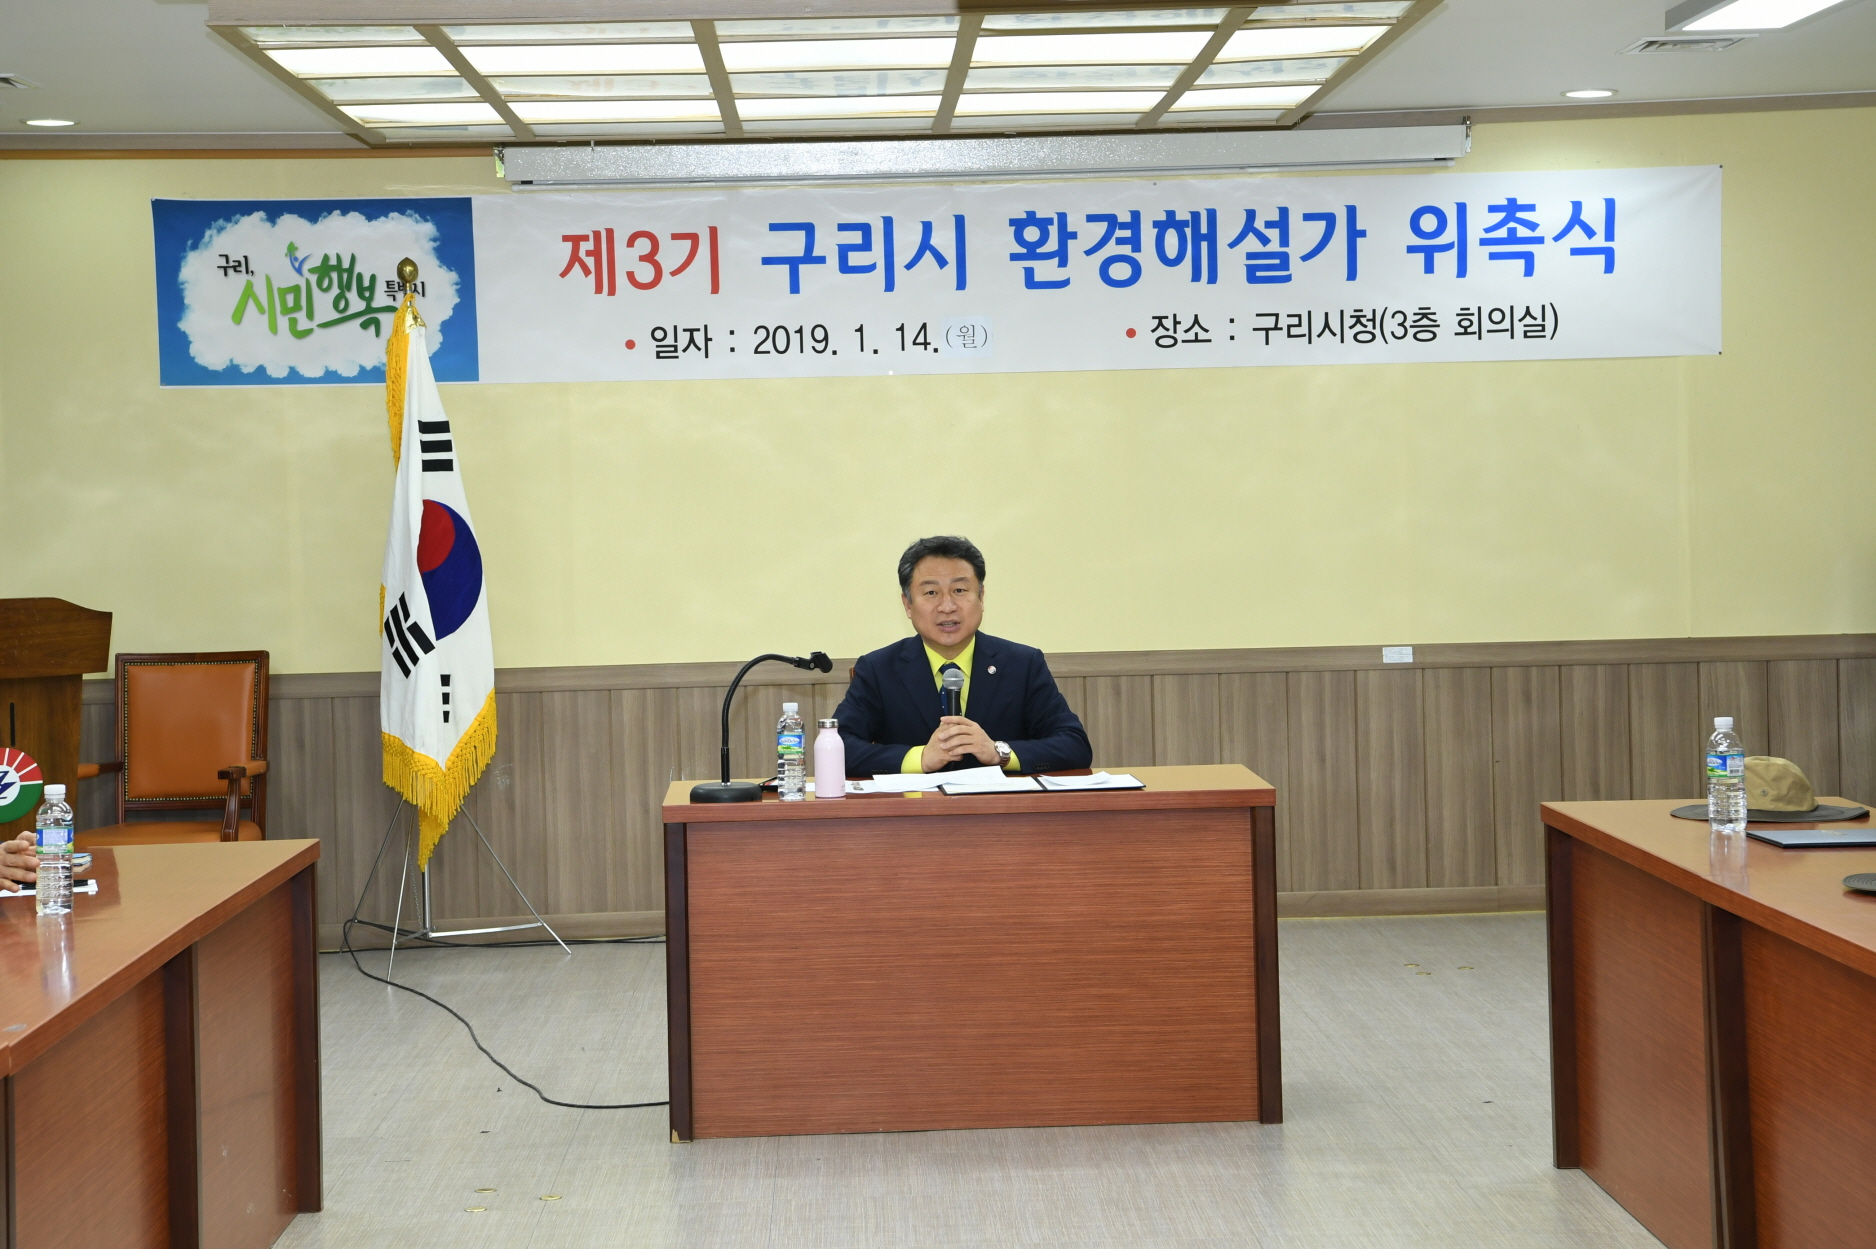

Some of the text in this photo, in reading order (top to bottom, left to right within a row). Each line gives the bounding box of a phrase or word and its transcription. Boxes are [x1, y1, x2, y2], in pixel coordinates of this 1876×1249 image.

[216, 253, 255, 277] 구리,
[559, 197, 1616, 297] 제3기 구리시 환경해설가 위촉식
[231, 252, 398, 339] 시민행복
[650, 323, 713, 360] 일자
[753, 324, 838, 356] 2019.
[854, 323, 879, 355] 1.
[1150, 313, 1212, 348] 장소
[1252, 306, 1441, 345] 구리시청(3층
[1454, 302, 1560, 341] 회의실)
